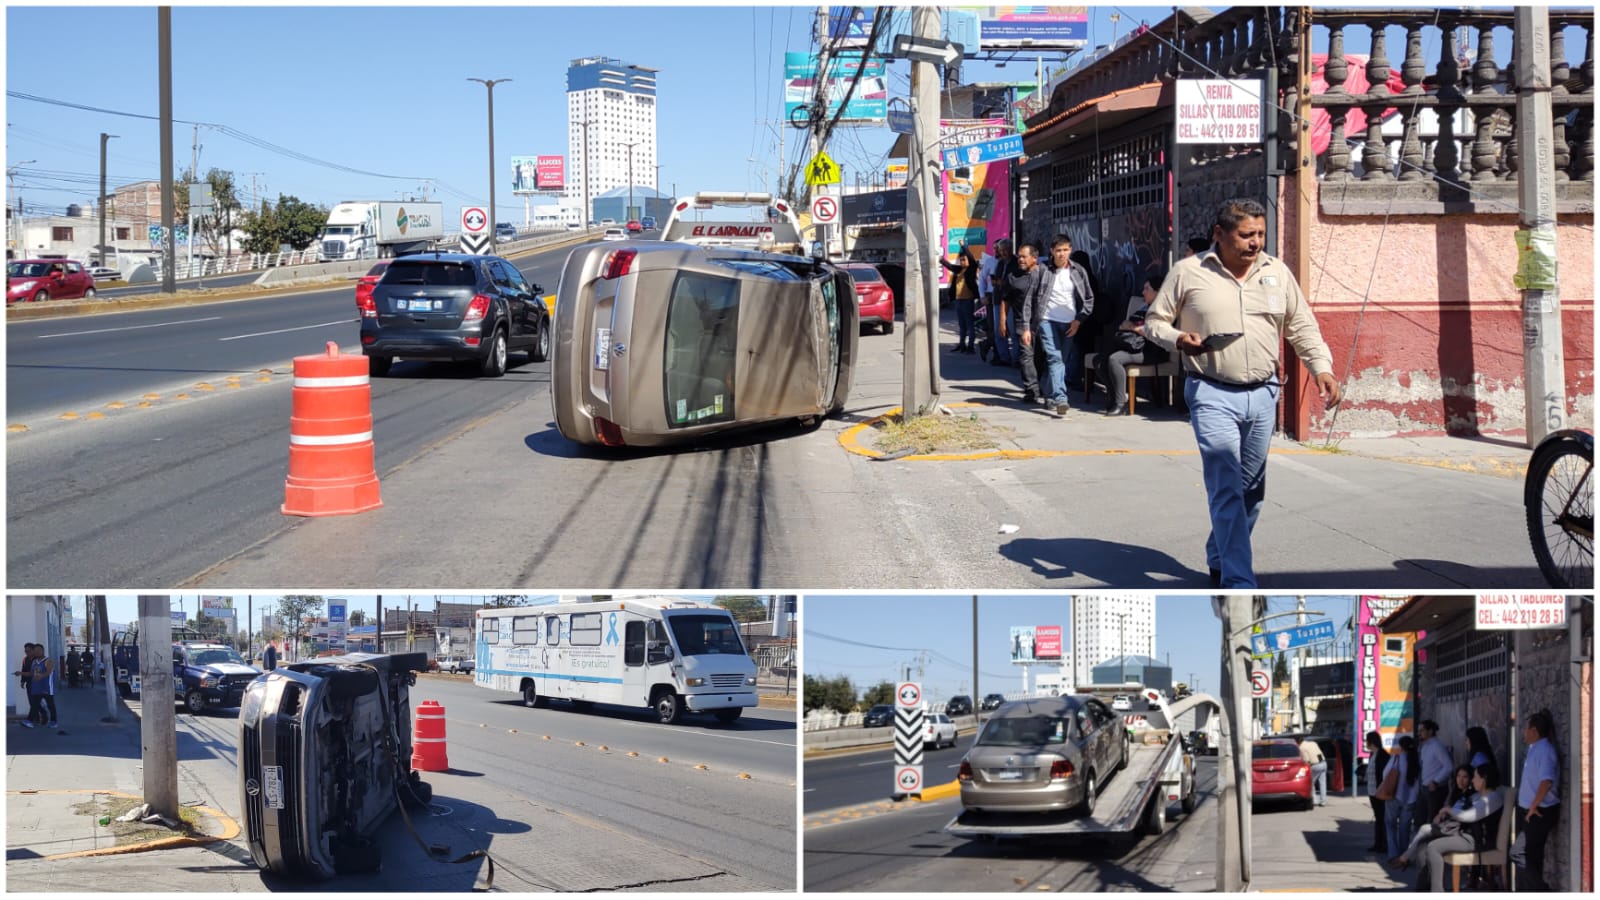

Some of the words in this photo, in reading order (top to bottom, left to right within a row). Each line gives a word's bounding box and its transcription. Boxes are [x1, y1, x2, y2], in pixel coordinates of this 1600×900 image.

[1206, 84, 1232, 99] RENTA
[1179, 103, 1208, 119] SILLAS
[1210, 103, 1216, 119] Y
[1217, 103, 1260, 119] TABLONES
[1179, 123, 1199, 138] CEL.:
[1201, 123, 1216, 138] 442
[1218, 123, 1234, 138] 219
[1236, 123, 1247, 138] 28
[1249, 123, 1259, 138] 51
[987, 139, 1021, 153] Tuxpan
[692, 225, 705, 236] EL
[1479, 609, 1500, 624] CEL.:
[1502, 609, 1518, 624] 442
[1521, 609, 1537, 624] 219
[1540, 609, 1551, 624] 28
[1554, 609, 1564, 624] 51
[1296, 625, 1332, 639] Tuxpan
[1362, 633, 1377, 752] BIENVENID
